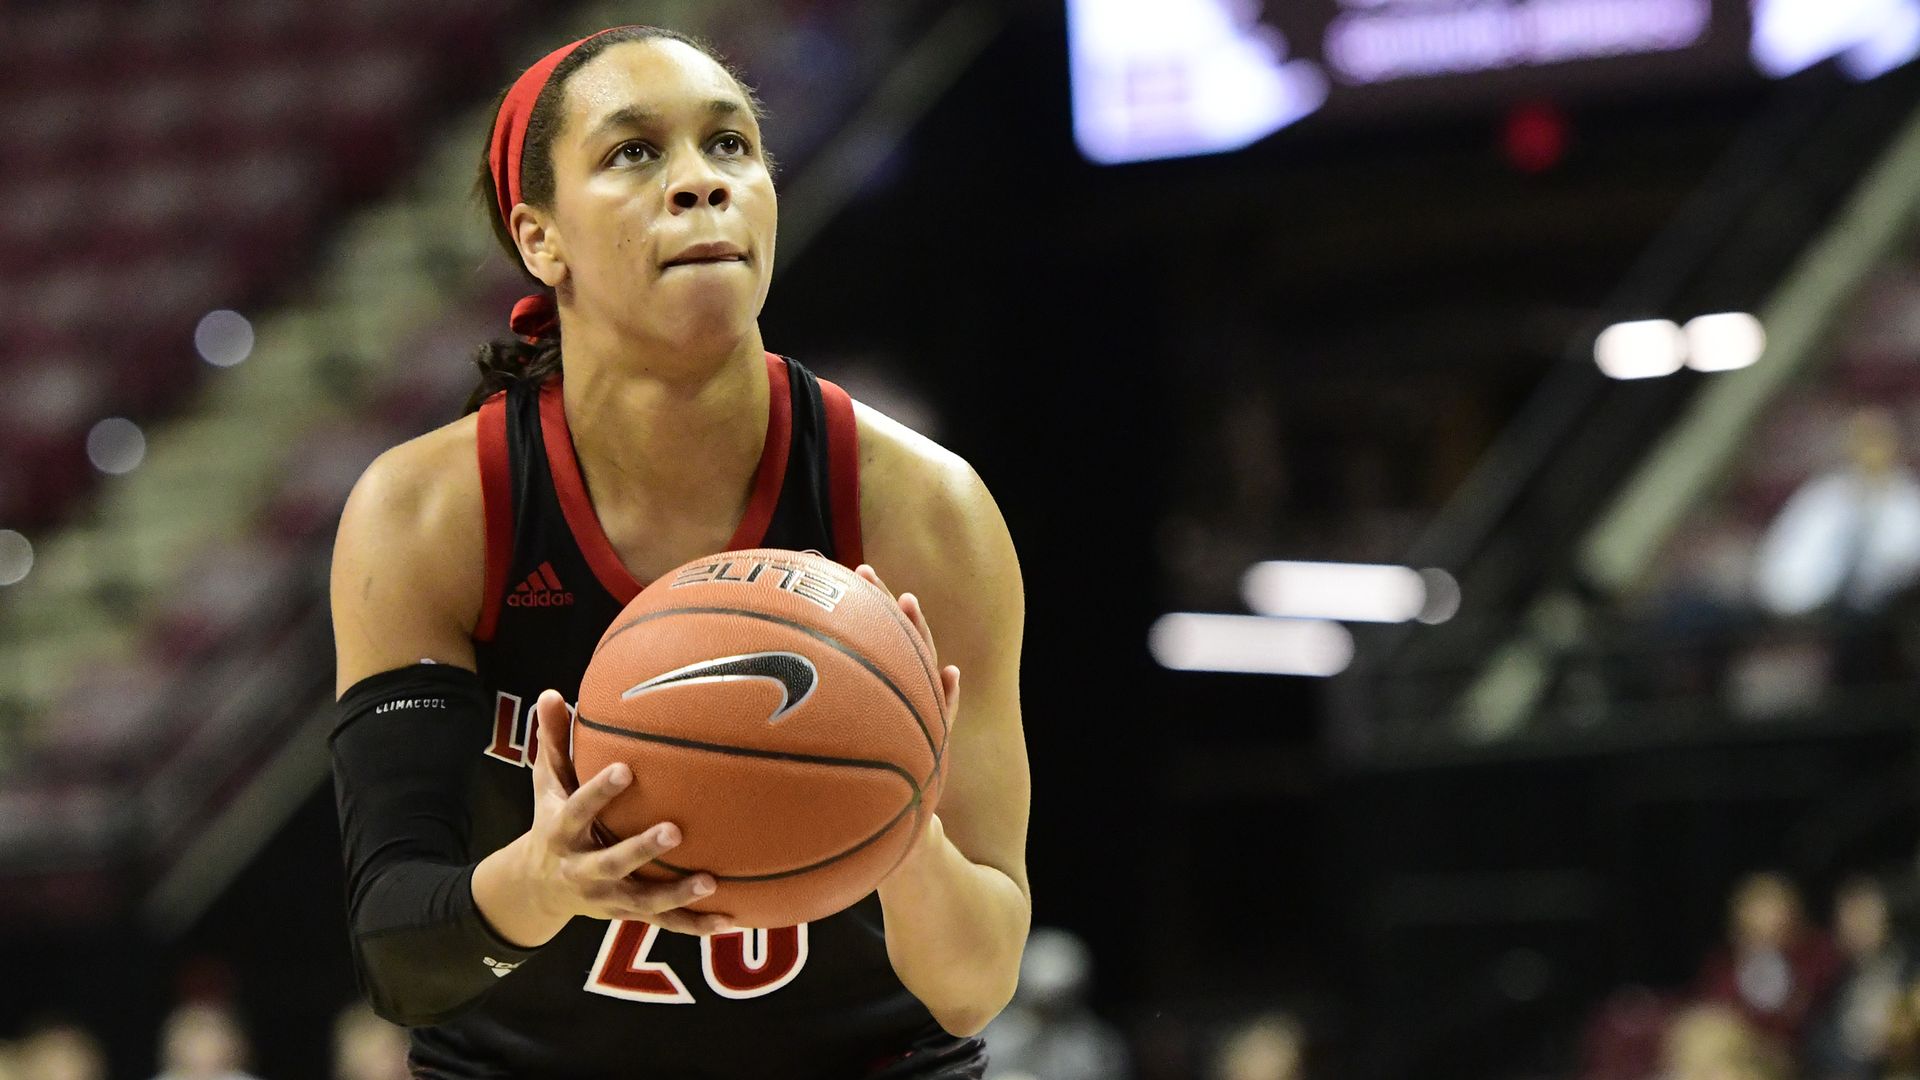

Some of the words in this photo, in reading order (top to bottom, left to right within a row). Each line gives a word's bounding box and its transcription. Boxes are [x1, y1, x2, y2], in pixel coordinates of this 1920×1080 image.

[669, 561, 849, 613] ELITE
[506, 590, 574, 607] adidas
[375, 698, 446, 714] CLIMACOOL
